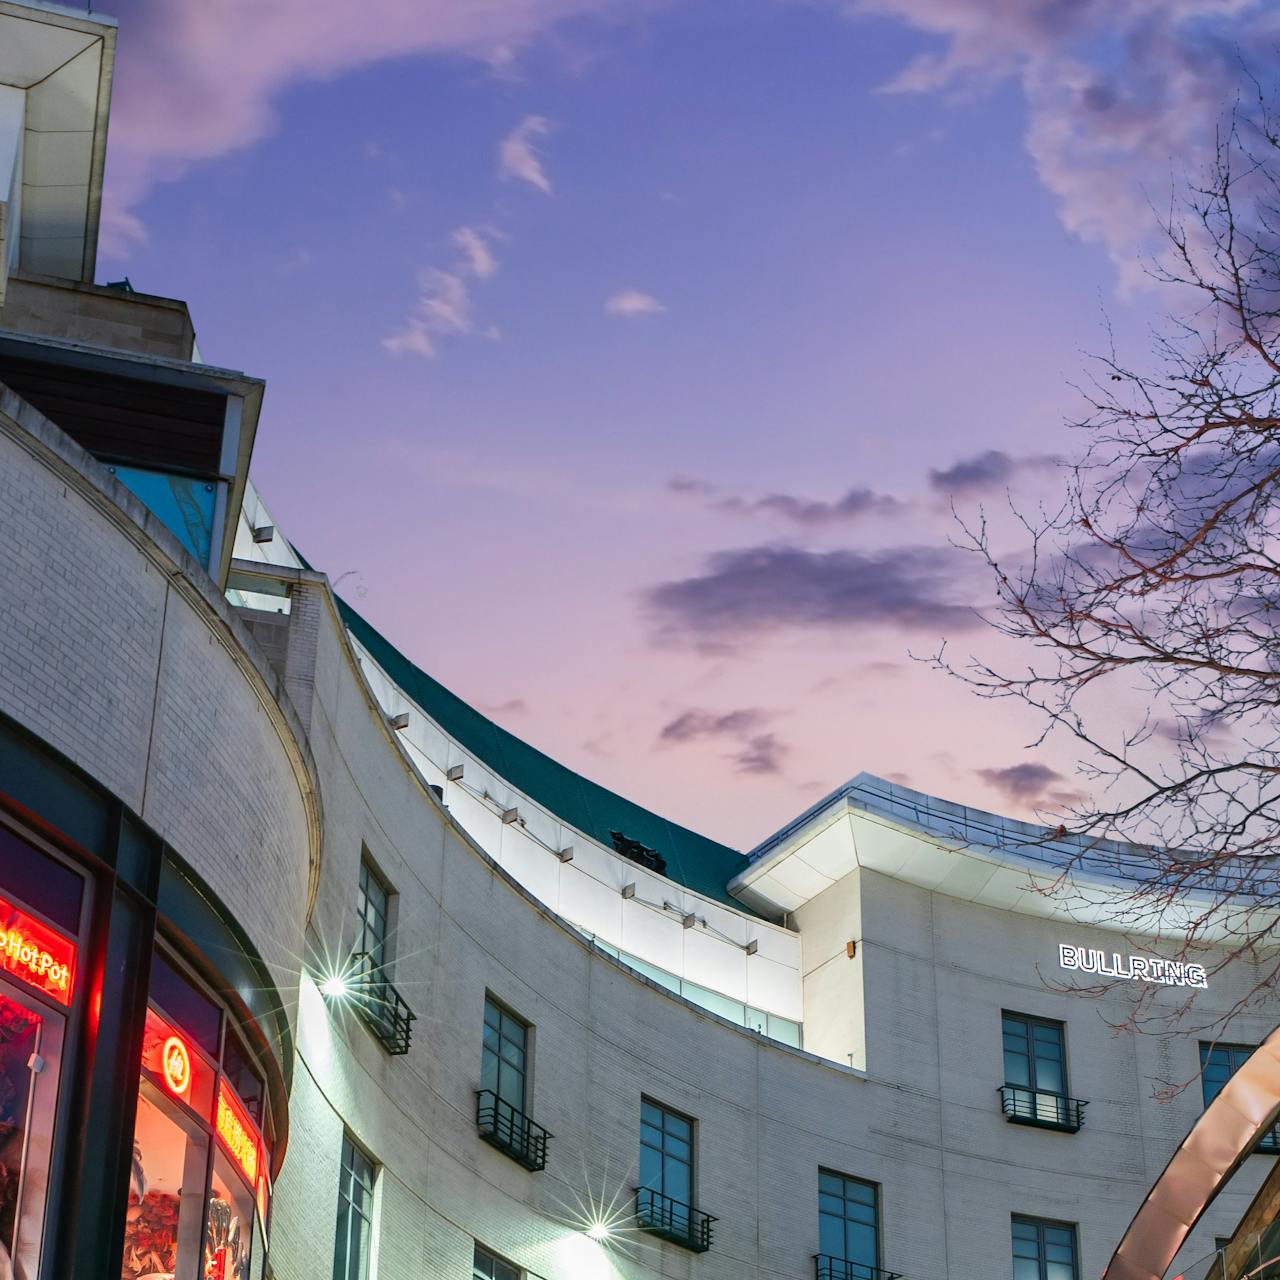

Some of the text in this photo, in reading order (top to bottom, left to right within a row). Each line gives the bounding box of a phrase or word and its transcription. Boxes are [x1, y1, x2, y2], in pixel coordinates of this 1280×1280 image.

[5, 929, 40, 973] Hot
[37, 951, 70, 991] Pot
[1058, 943, 1209, 989] BULLRING
